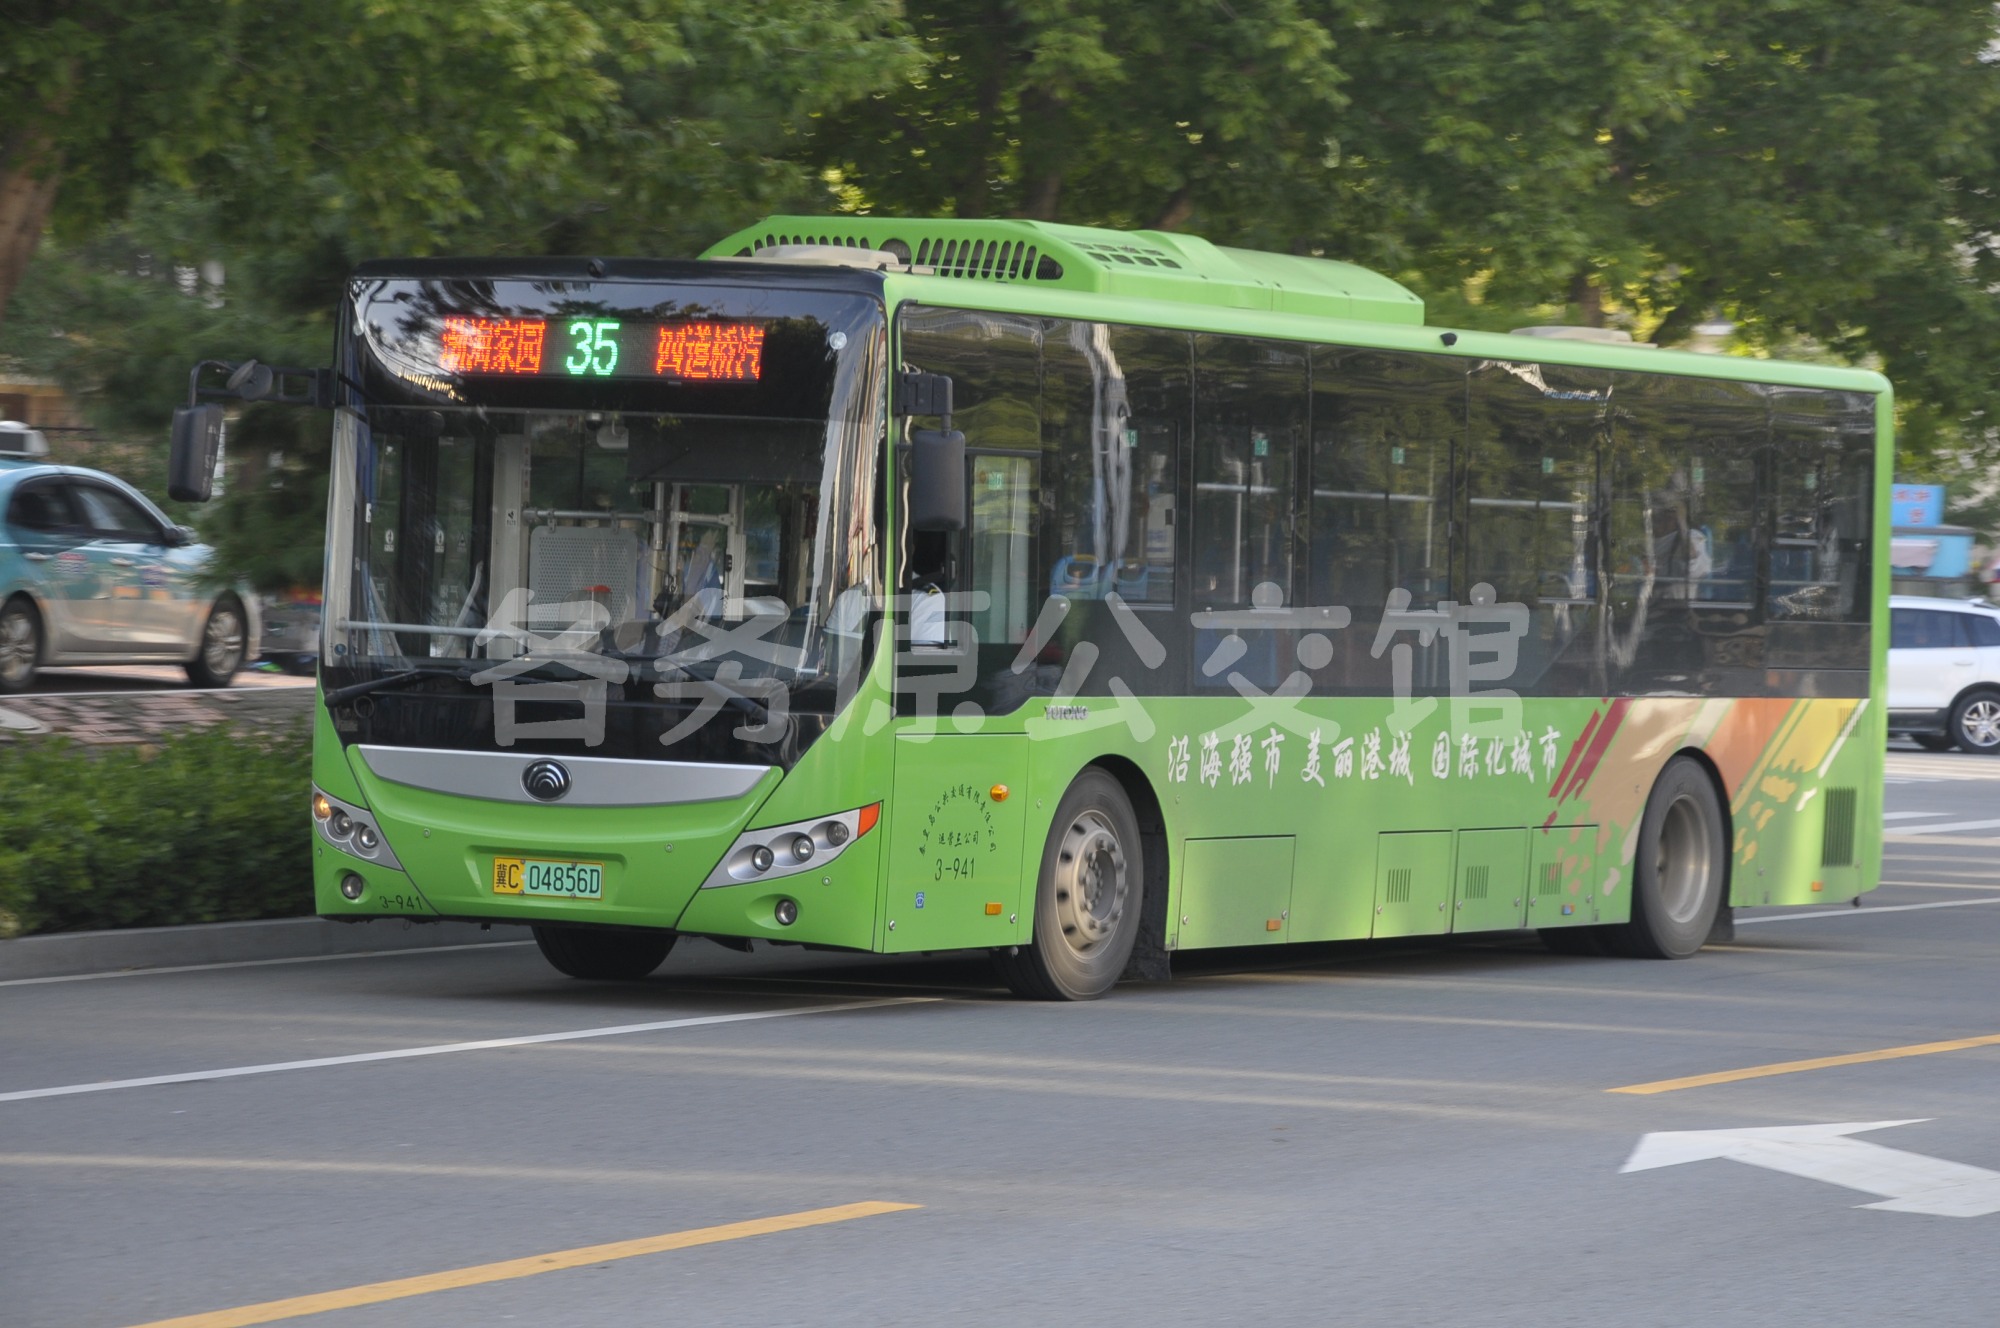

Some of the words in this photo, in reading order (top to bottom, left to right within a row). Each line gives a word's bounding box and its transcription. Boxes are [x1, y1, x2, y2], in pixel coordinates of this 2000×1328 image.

[566, 321, 620, 375] 35
[1167, 727, 1286, 790] 沿海强市
[1300, 725, 1414, 787] 美丽港城
[1430, 724, 1562, 785] 国际化城市
[934, 857, 975, 881] 3-941
[380, 895, 424, 911] 3-941
